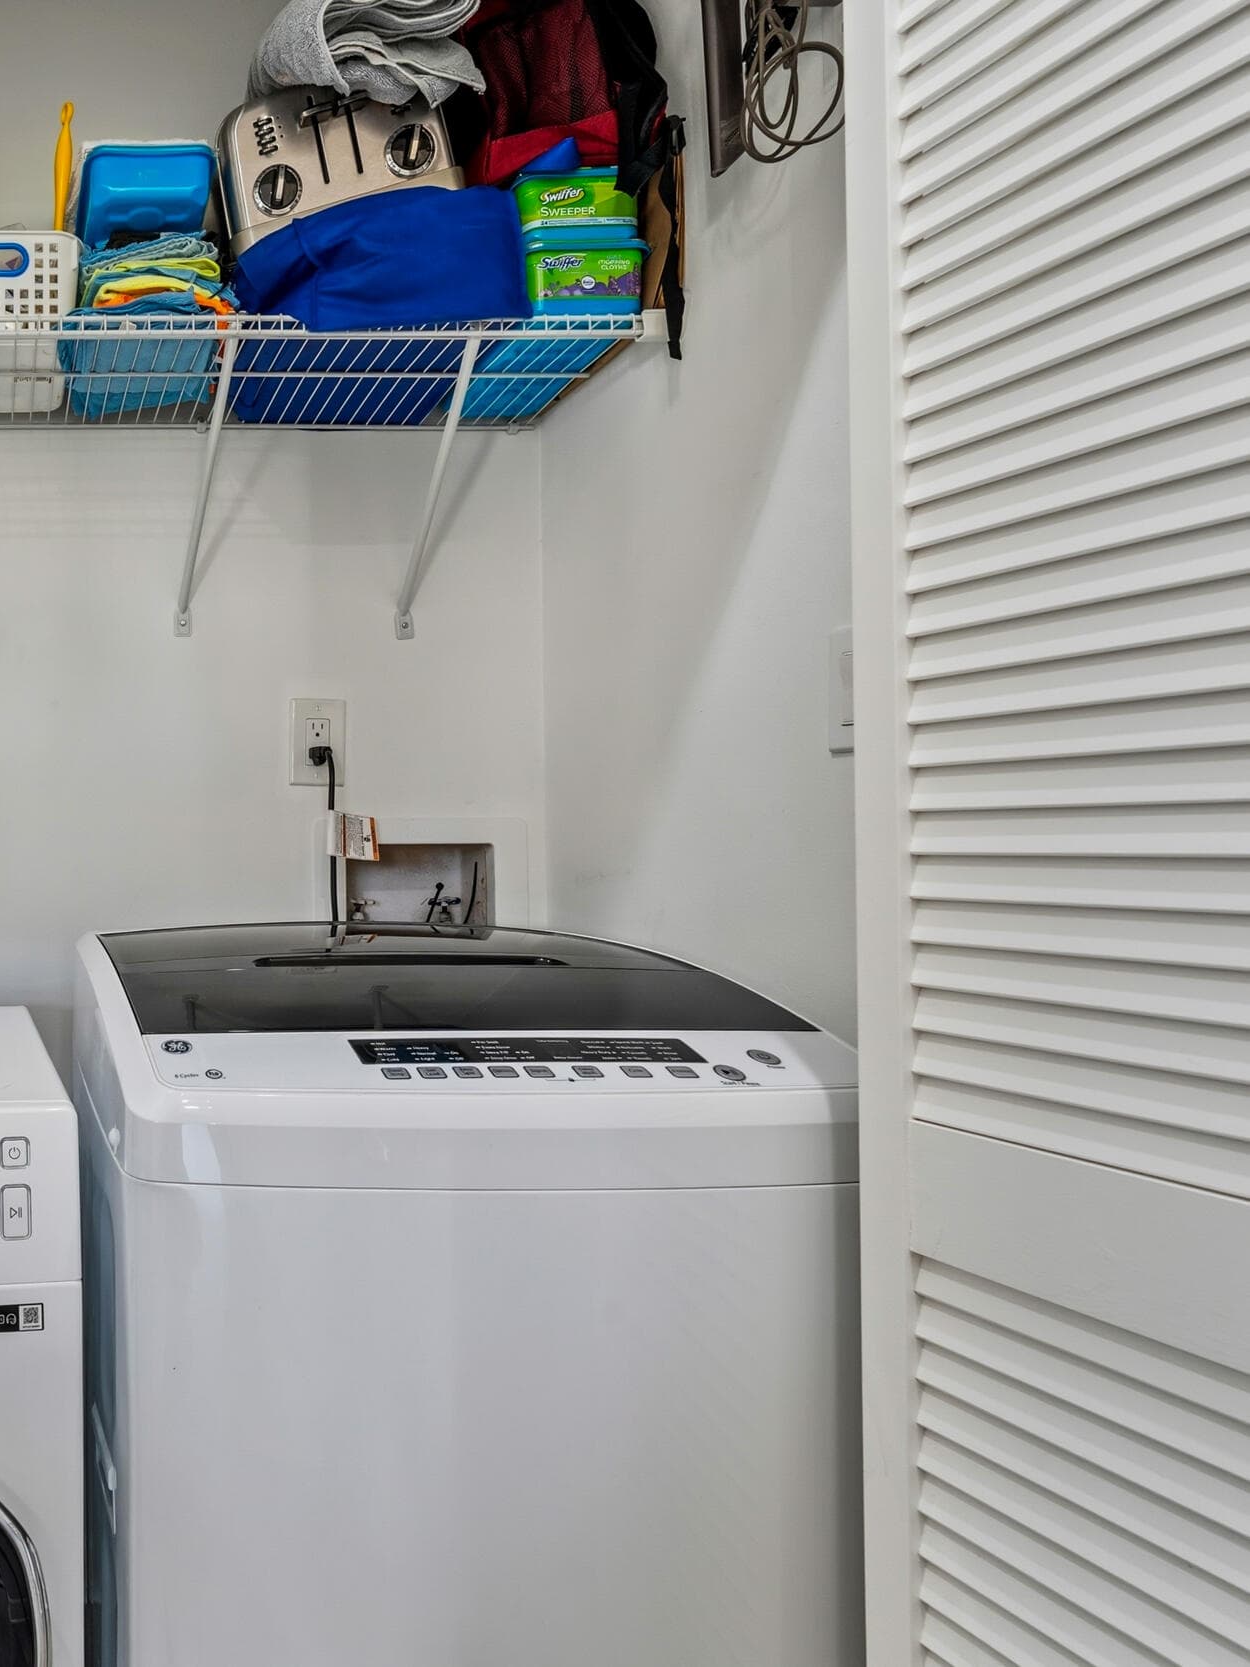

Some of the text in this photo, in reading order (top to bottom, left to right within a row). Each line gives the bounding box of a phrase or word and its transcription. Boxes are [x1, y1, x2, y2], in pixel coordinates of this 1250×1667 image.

[542, 187, 584, 204] Swiffer
[540, 206, 596, 216] SWEEPER
[537, 254, 586, 271] Swiffer
